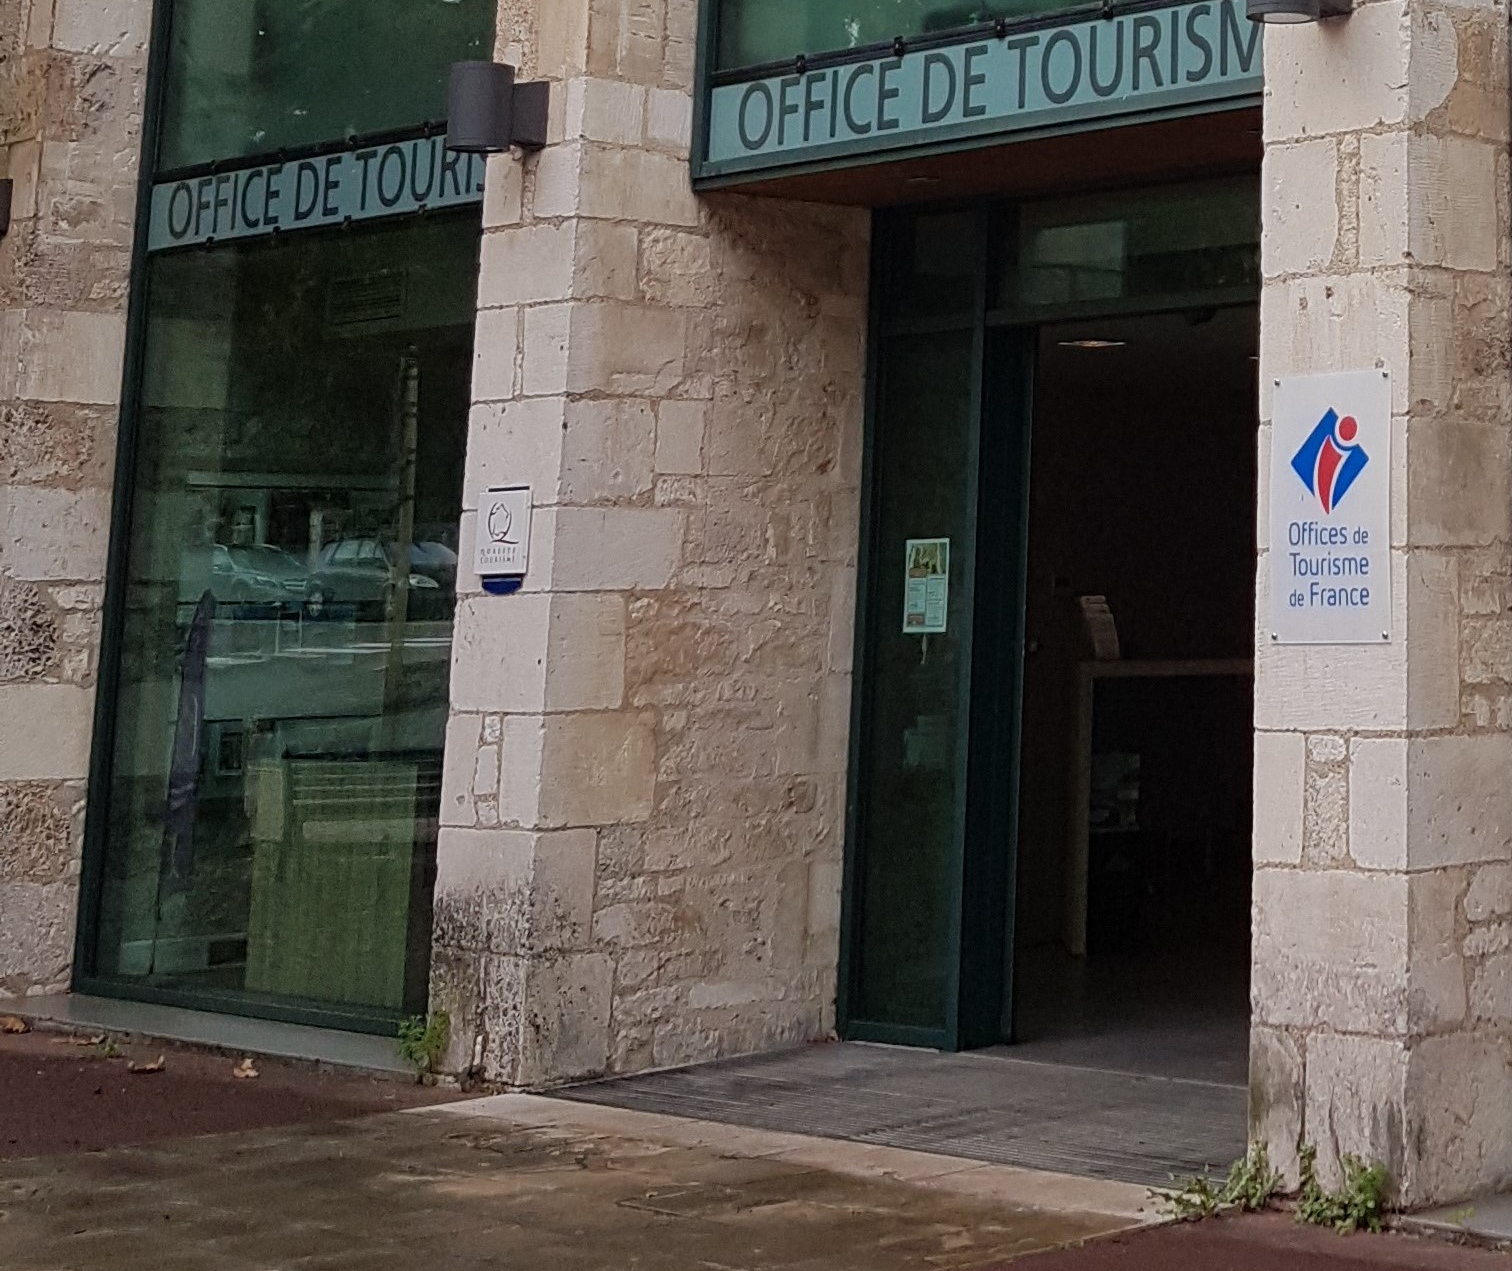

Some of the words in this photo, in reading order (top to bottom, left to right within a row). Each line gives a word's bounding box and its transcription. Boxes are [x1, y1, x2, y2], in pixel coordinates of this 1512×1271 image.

[738, 60, 901, 151] OFFICE
[921, 44, 988, 125] DE
[167, 166, 283, 240] OFFICE
[294, 156, 342, 222] DE
[355, 138, 486, 211] TOURI
[1288, 521, 1348, 546] Offices
[1353, 526, 1369, 545] de
[1289, 551, 1370, 577] Tourisme
[1289, 589, 1305, 608] de
[1309, 582, 1370, 607] France
